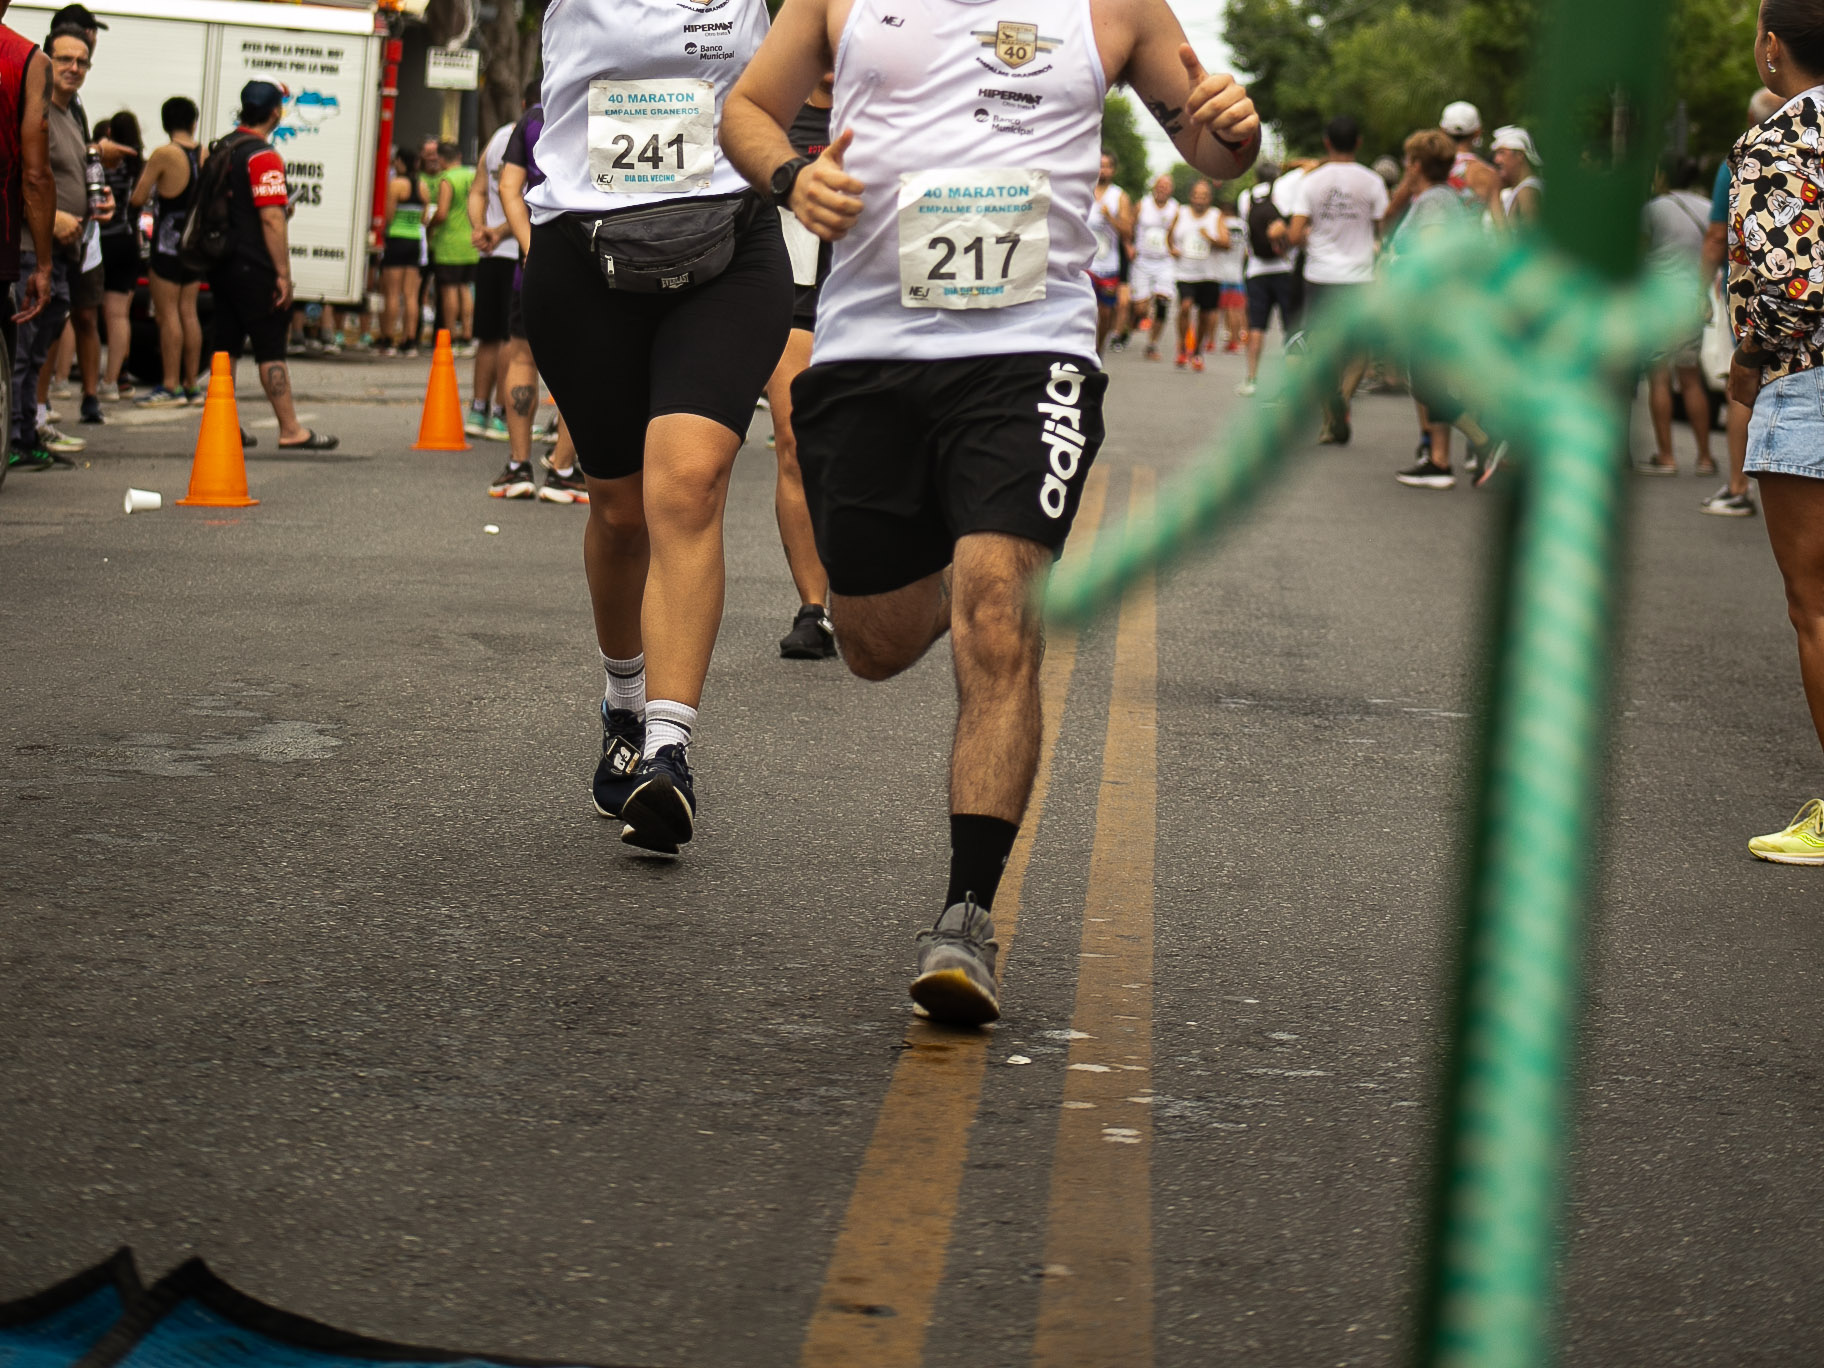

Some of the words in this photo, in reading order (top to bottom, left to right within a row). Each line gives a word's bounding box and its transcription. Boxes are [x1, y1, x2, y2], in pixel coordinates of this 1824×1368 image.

[700, 50, 735, 61] Municipal
[1004, 47, 1027, 60] 40
[608, 94, 624, 104] 40
[628, 93, 695, 103] MARATON
[650, 107, 700, 116] GRANEROS
[993, 114, 1021, 126] Banco
[992, 124, 1034, 136] Municipal
[611, 133, 685, 170] 241
[624, 174, 636, 182] DIA
[637, 174, 649, 182] DEL
[650, 174, 675, 182] VECINO
[923, 187, 942, 199] 40
[948, 185, 1030, 199] MARATON
[919, 204, 971, 214] EMPALME
[975, 202, 1033, 213] GRANEROS
[927, 232, 1021, 280] 217
[661, 273, 689, 289] EVERLAST
